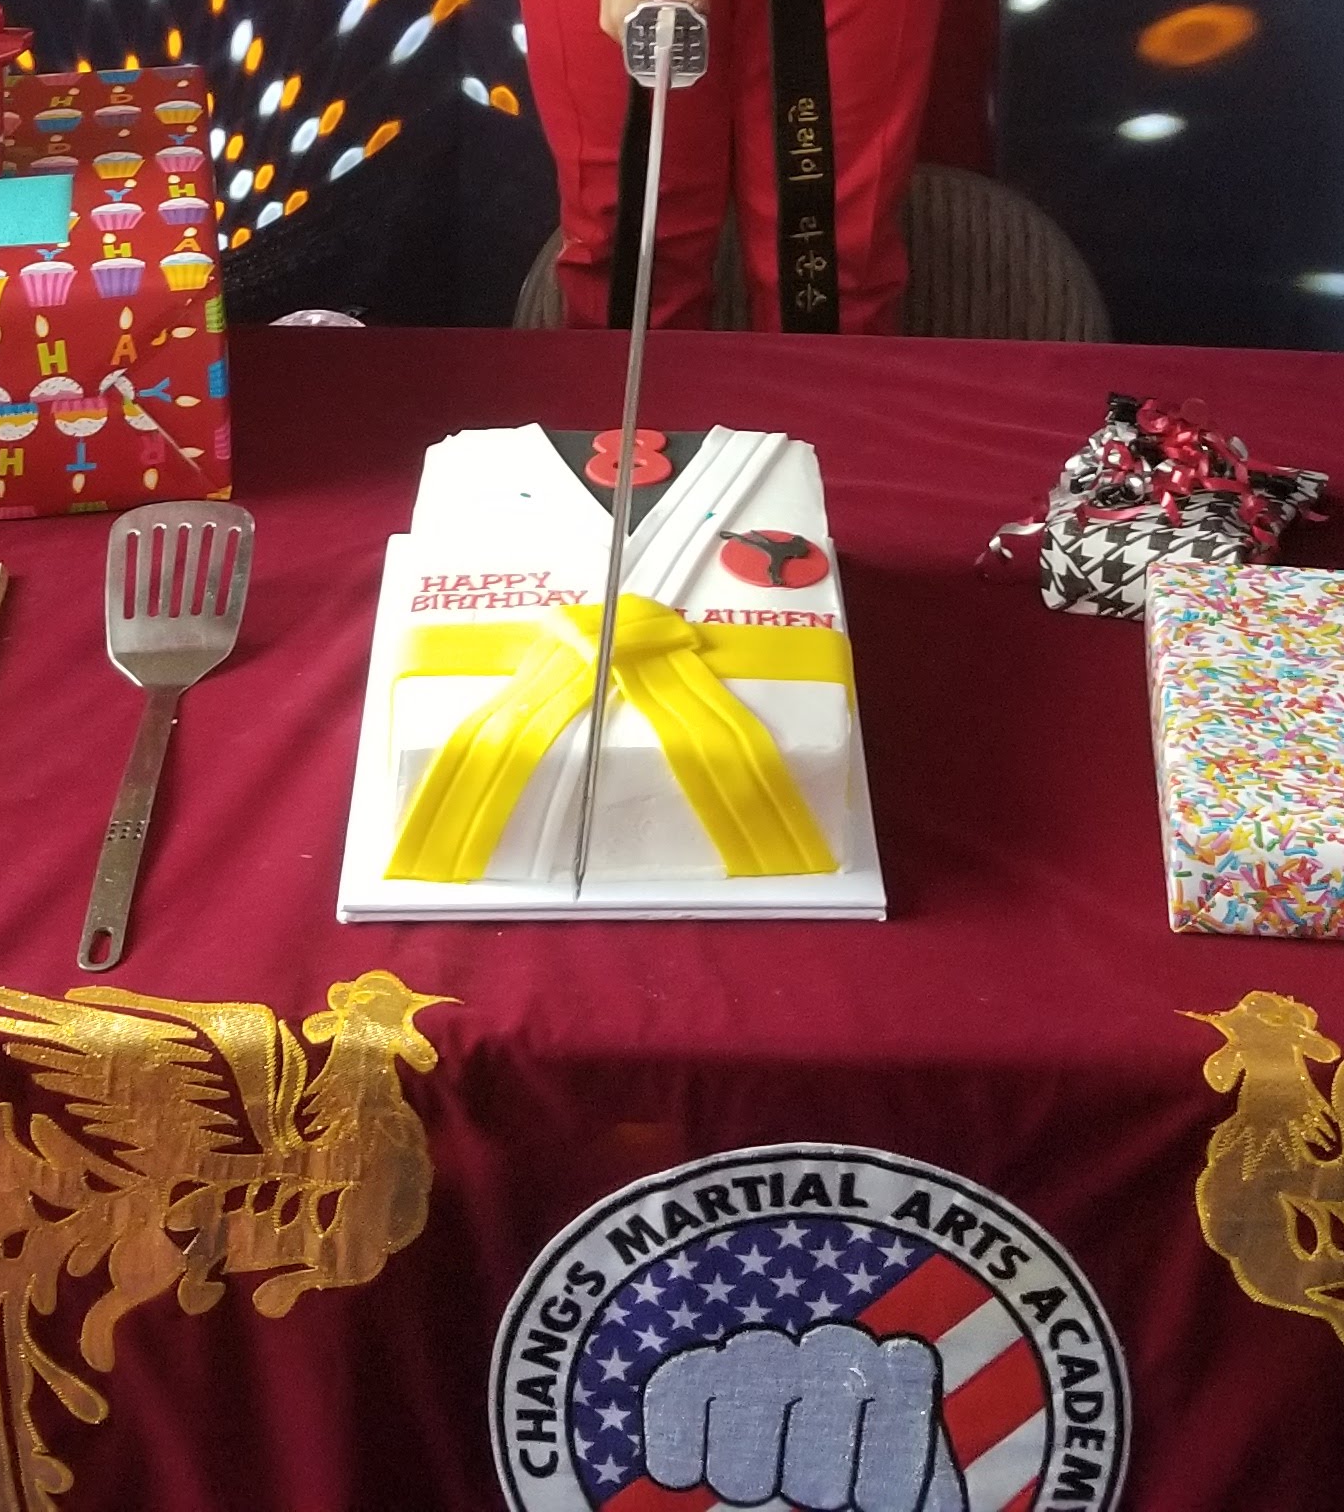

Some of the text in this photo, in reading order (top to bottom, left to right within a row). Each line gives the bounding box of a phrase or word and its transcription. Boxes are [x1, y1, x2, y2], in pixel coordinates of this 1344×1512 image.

[419, 571, 552, 593] HAPPY
[410, 589, 589, 613] BIRTHDAY
[515, 1171, 1108, 1512] CHANG'S MARTIAL ARTS ACADEM
